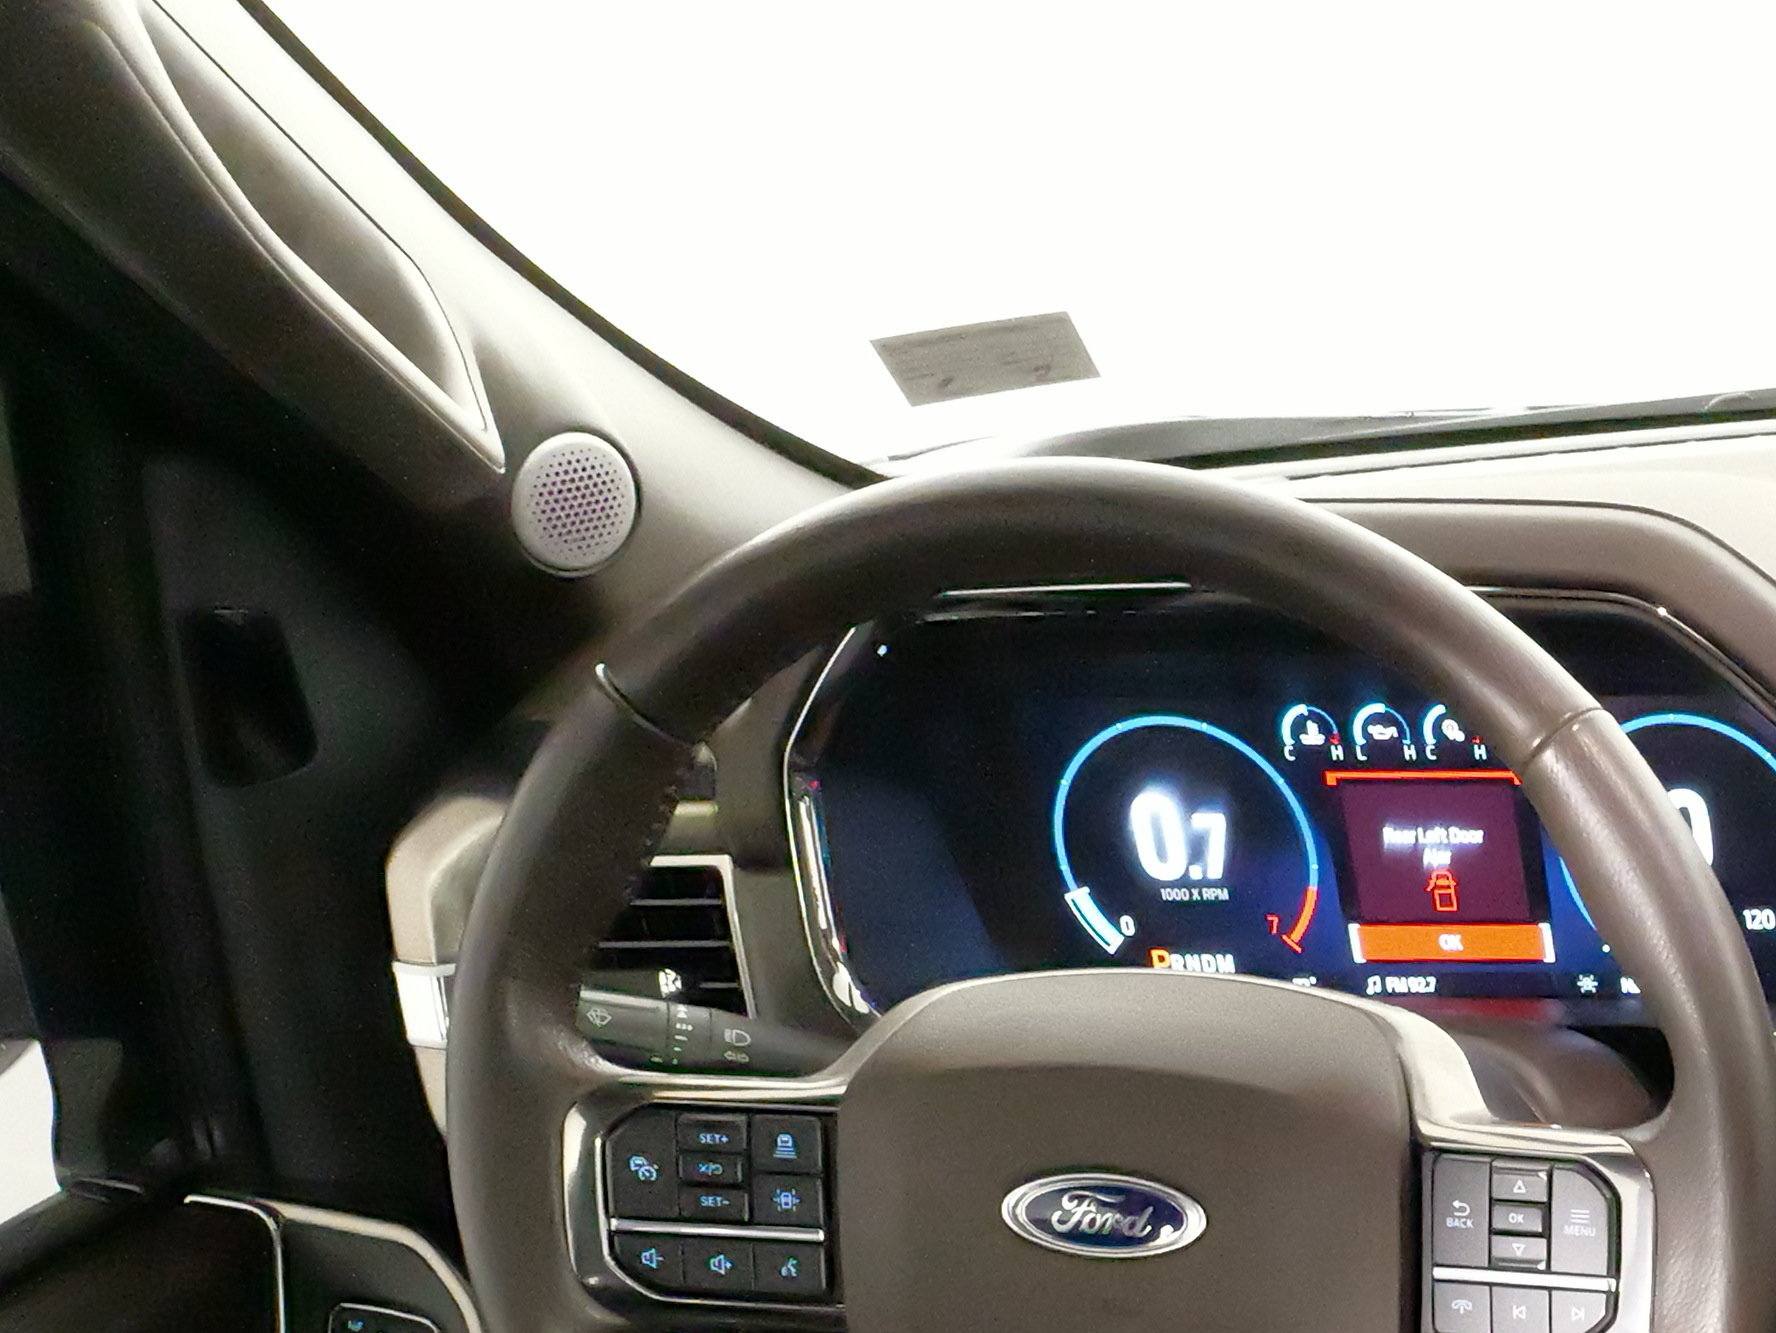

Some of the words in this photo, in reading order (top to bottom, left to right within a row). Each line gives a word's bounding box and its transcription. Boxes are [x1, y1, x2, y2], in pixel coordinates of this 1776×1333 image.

[1331, 745, 1345, 761] H
[1403, 745, 1417, 761] H
[1473, 745, 1488, 761] H
[1130, 792, 1227, 881] 0.7
[1160, 887, 1189, 901] 1000
[1202, 887, 1230, 901] RPM
[1119, 914, 1136, 937] 0
[1264, 913, 1280, 935] 7
[1742, 908, 1776, 931] 120
[1050, 1189, 1153, 1239] Ford
[1508, 1212, 1525, 1224] OK
[1445, 1217, 1474, 1229] BACK
[1563, 1225, 1597, 1237] MENU
